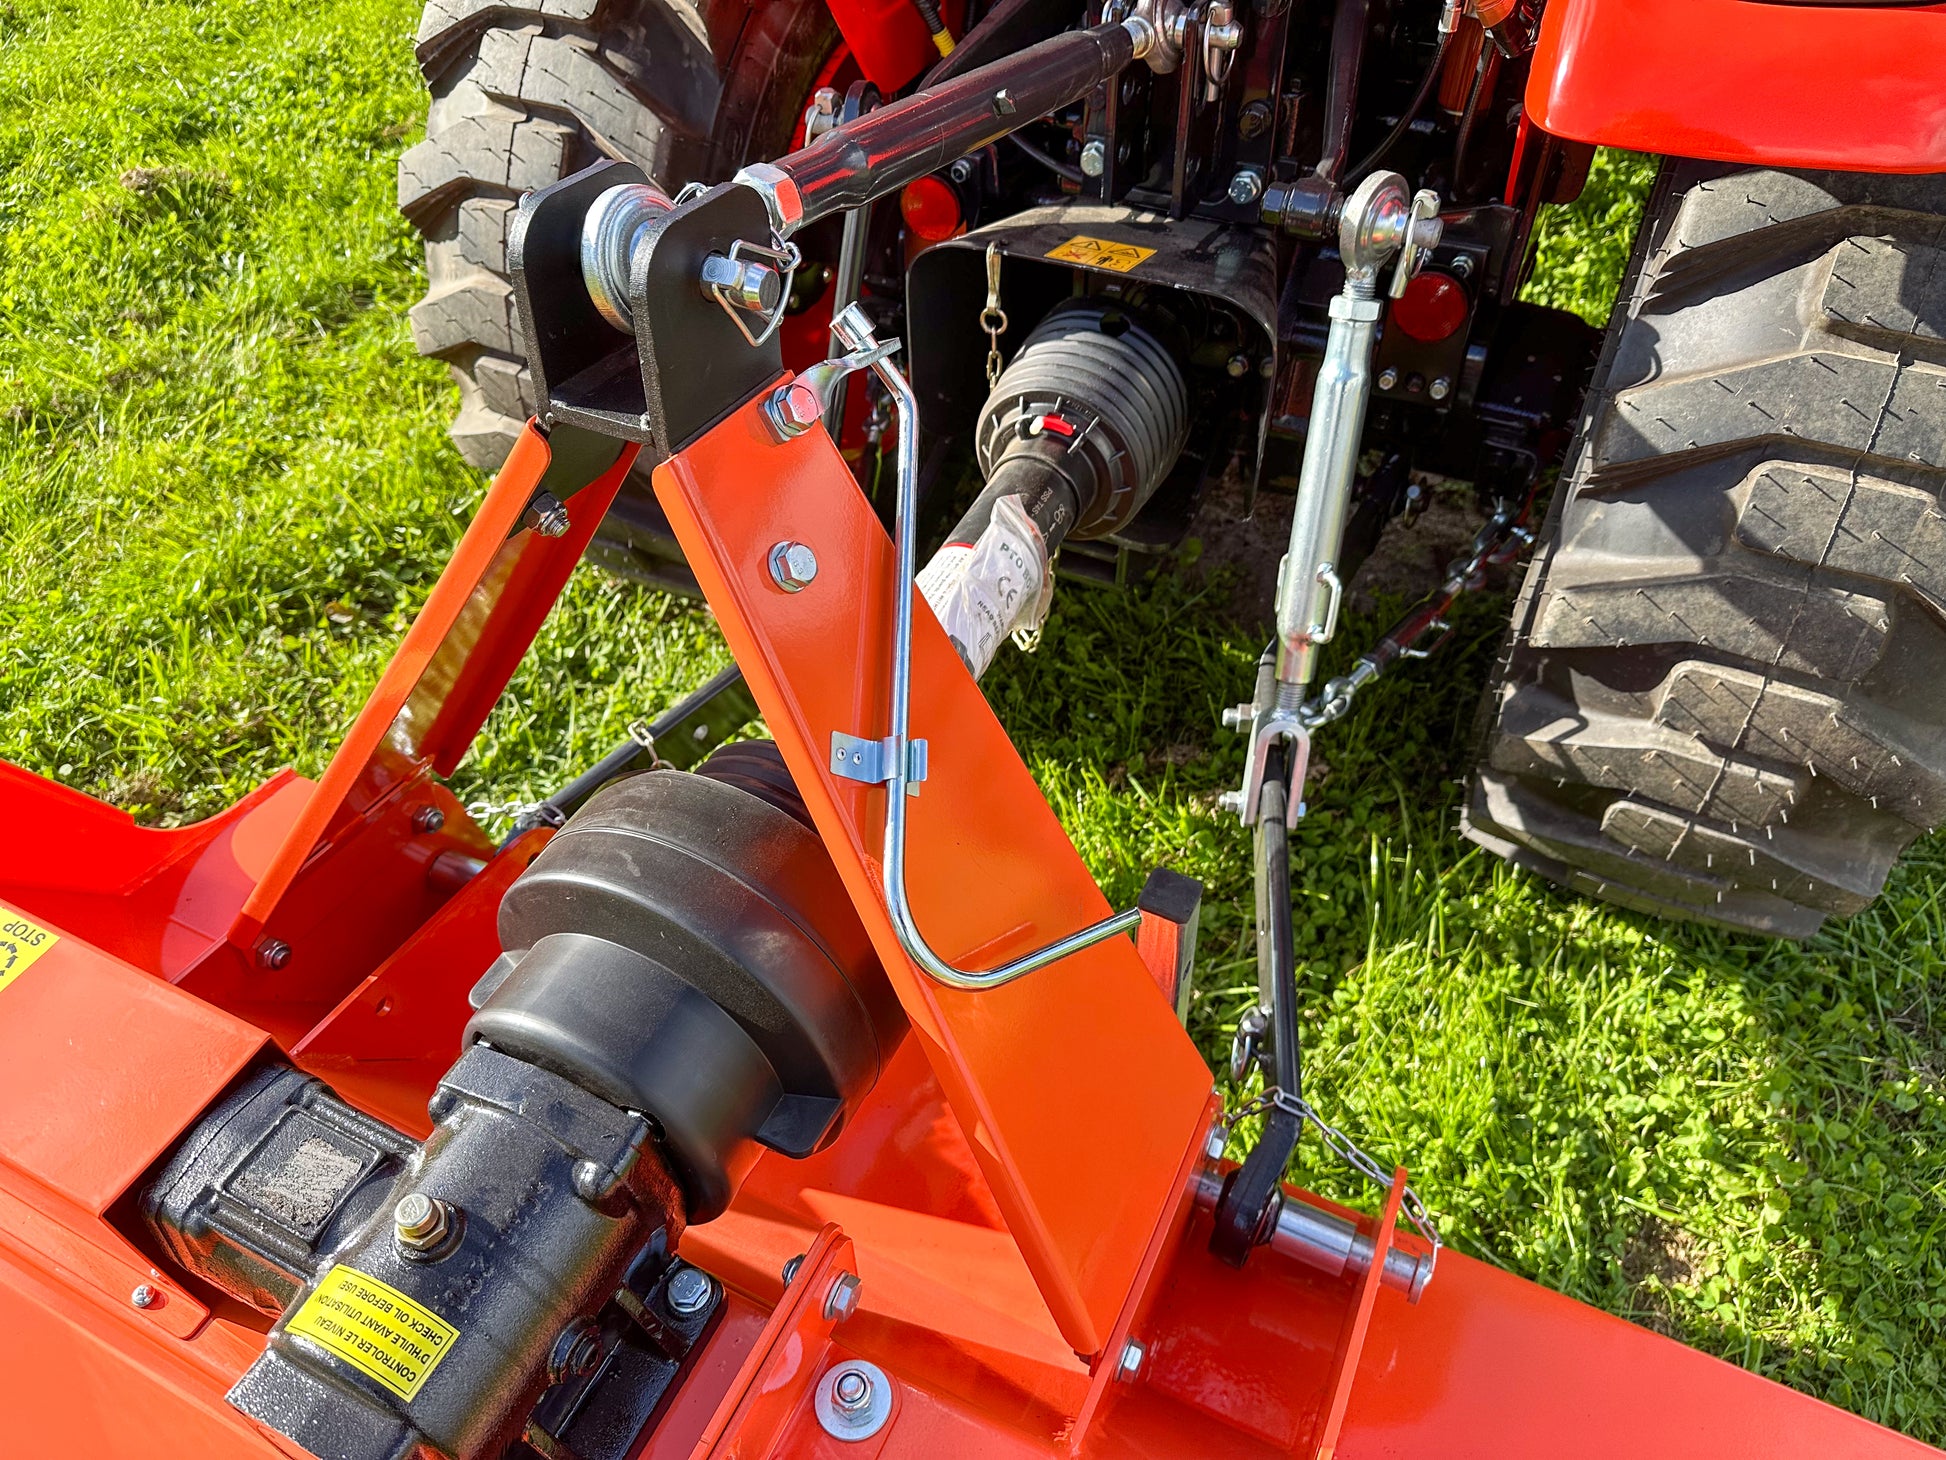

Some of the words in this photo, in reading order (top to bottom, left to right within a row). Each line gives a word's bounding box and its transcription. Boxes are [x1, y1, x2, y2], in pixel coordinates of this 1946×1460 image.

[1000, 543, 1023, 568] PTO
[3, 920, 46, 946] STOP
[355, 1287, 394, 1313] BEFORE
[313, 1315, 347, 1338] NIVEAU
[393, 1308, 410, 1323] OIL
[343, 1331, 358, 1345] LE
[359, 1318, 392, 1340] AVANT
[407, 1318, 444, 1347] CHECK
[356, 1339, 417, 1383] CONTROLER
[390, 1335, 431, 1366] D'HUILE
